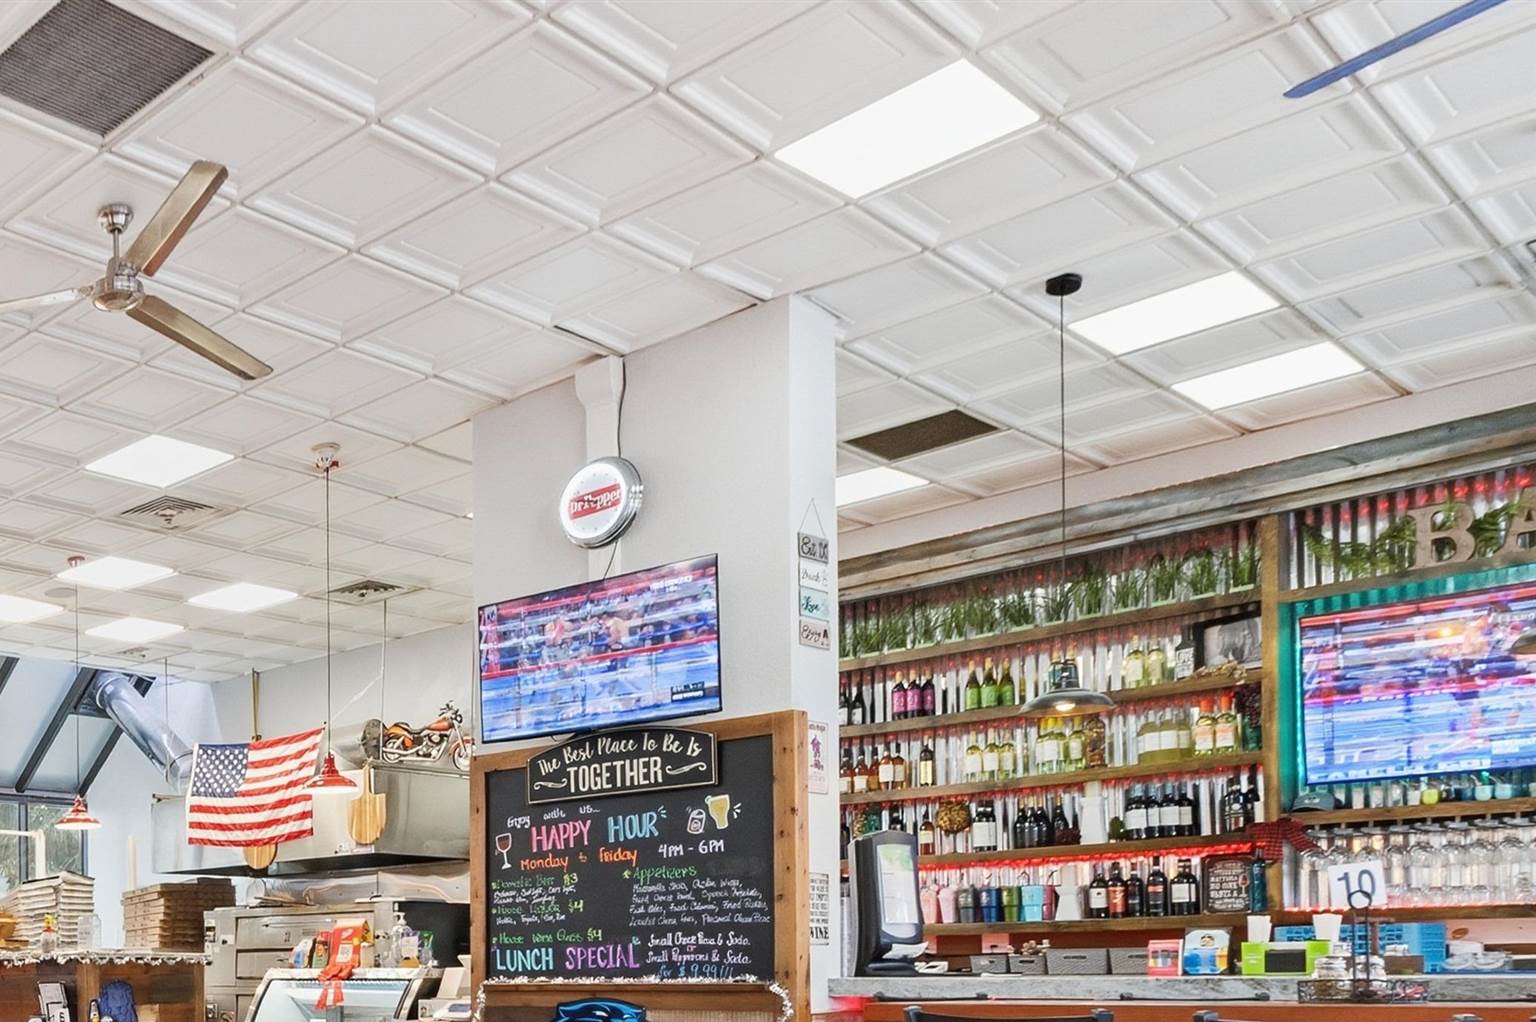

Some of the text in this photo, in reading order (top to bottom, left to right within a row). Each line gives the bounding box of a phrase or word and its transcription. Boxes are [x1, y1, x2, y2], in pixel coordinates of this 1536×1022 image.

[583, 489, 621, 510] Pepper
[538, 732, 702, 776] The Best Place To Be Is
[567, 756, 663, 793] TOGETHER
[530, 812, 659, 853] HAPPY HOUR
[659, 844, 684, 858] 4PM
[698, 840, 725, 854] 6PM
[520, 853, 568, 872] Monday
[633, 866, 697, 885] Appetizers
[1337, 869, 1376, 898] 10
[568, 899, 583, 913] $4
[587, 928, 602, 942] $4
[497, 943, 640, 971] LUNCH SPECIAL
